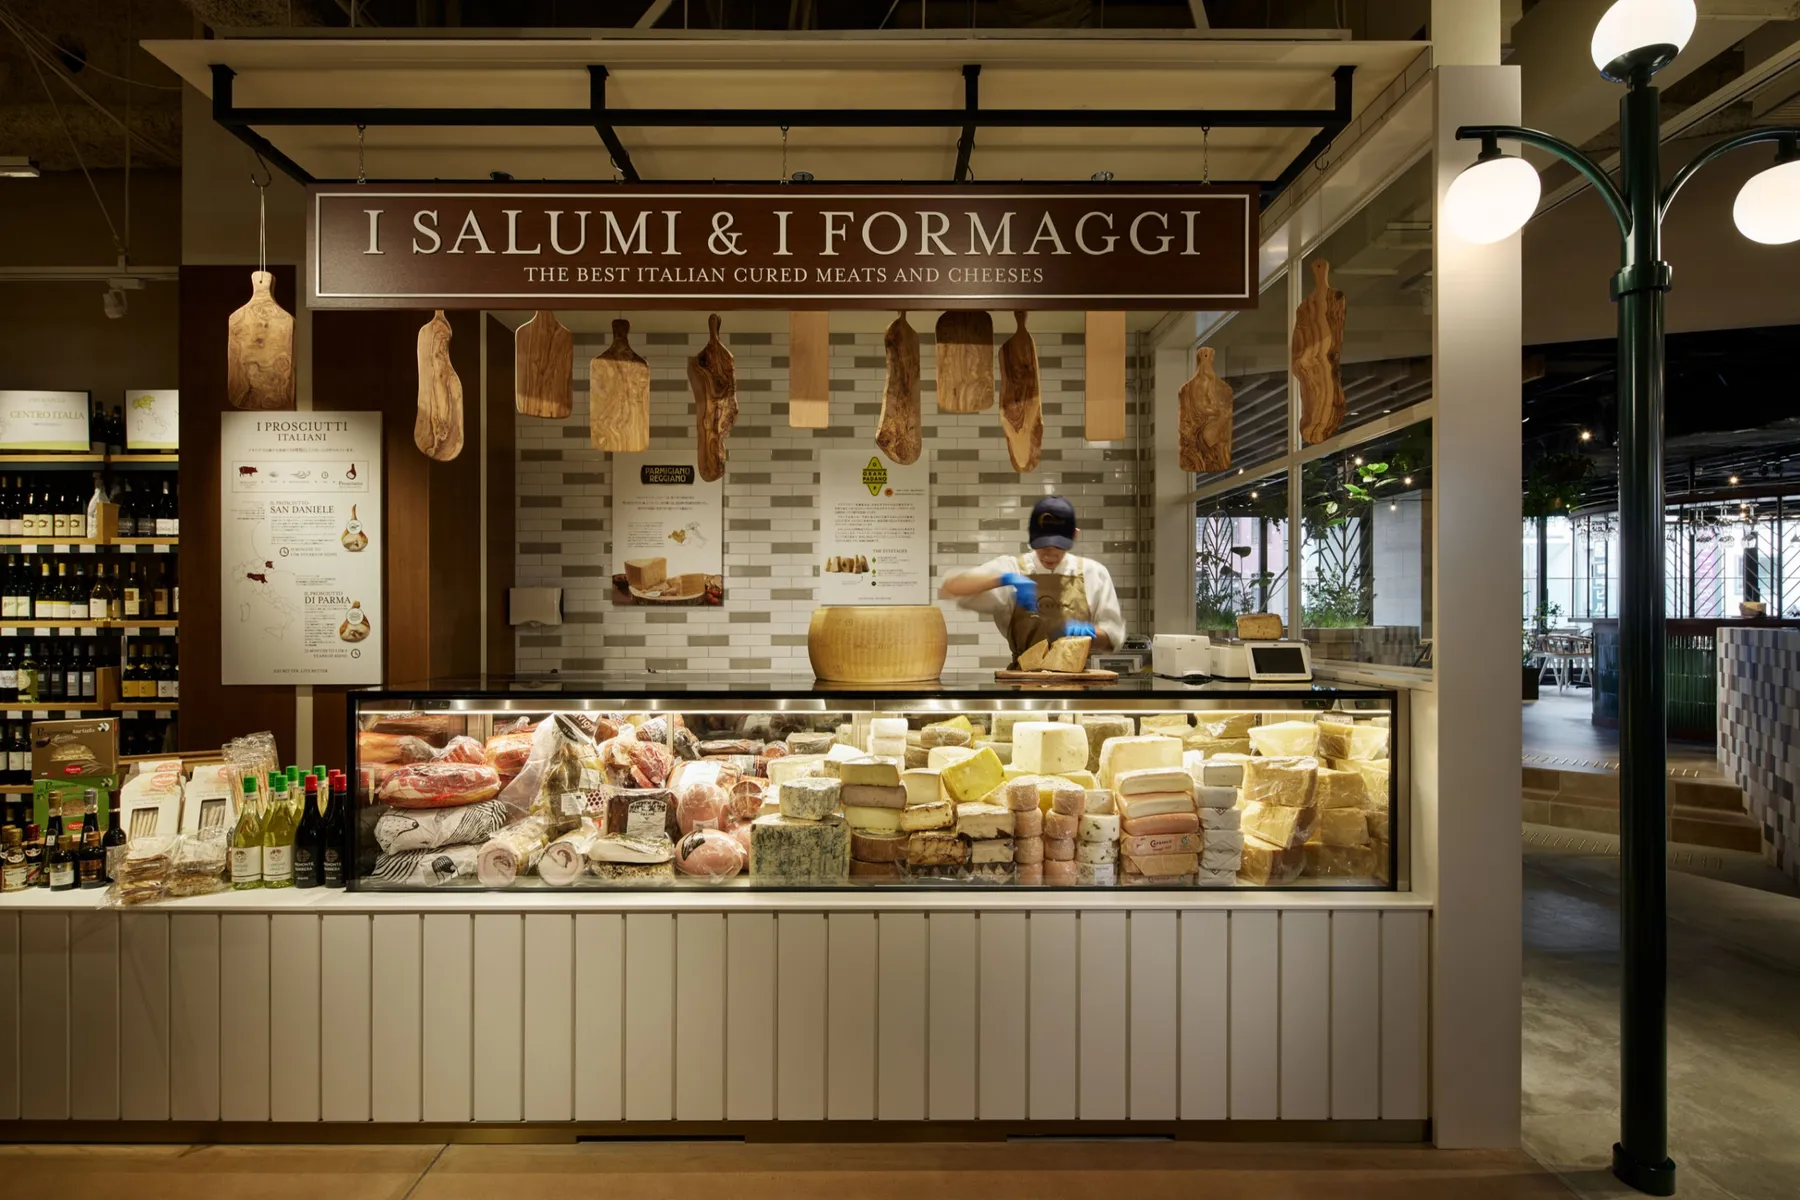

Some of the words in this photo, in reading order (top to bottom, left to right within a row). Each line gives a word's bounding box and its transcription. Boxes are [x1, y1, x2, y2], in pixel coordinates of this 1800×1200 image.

[363, 209, 384, 254] I
[412, 209, 682, 255] SALUMI
[707, 211, 748, 256] &
[773, 210, 794, 255] I
[818, 210, 1201, 255] FORMAGGI
[524, 267, 569, 283] THE
[577, 267, 630, 283] BEST
[637, 267, 726, 283] ITALIAN
[734, 267, 808, 283] CURED
[816, 267, 888, 283] MEATS
[895, 267, 940, 283] AND
[948, 267, 1044, 283] CHEESES
[9, 410, 51, 420] CENTRO
[53, 410, 86, 420] ITALIA
[265, 422, 348, 432] PROSCIUTTI
[278, 433, 327, 441] ITALIANI
[645, 467, 691, 475] PARMIGIANO
[649, 475, 687, 483] REGGIANO
[270, 505, 290, 513] SAN
[292, 505, 335, 513] DANIELE
